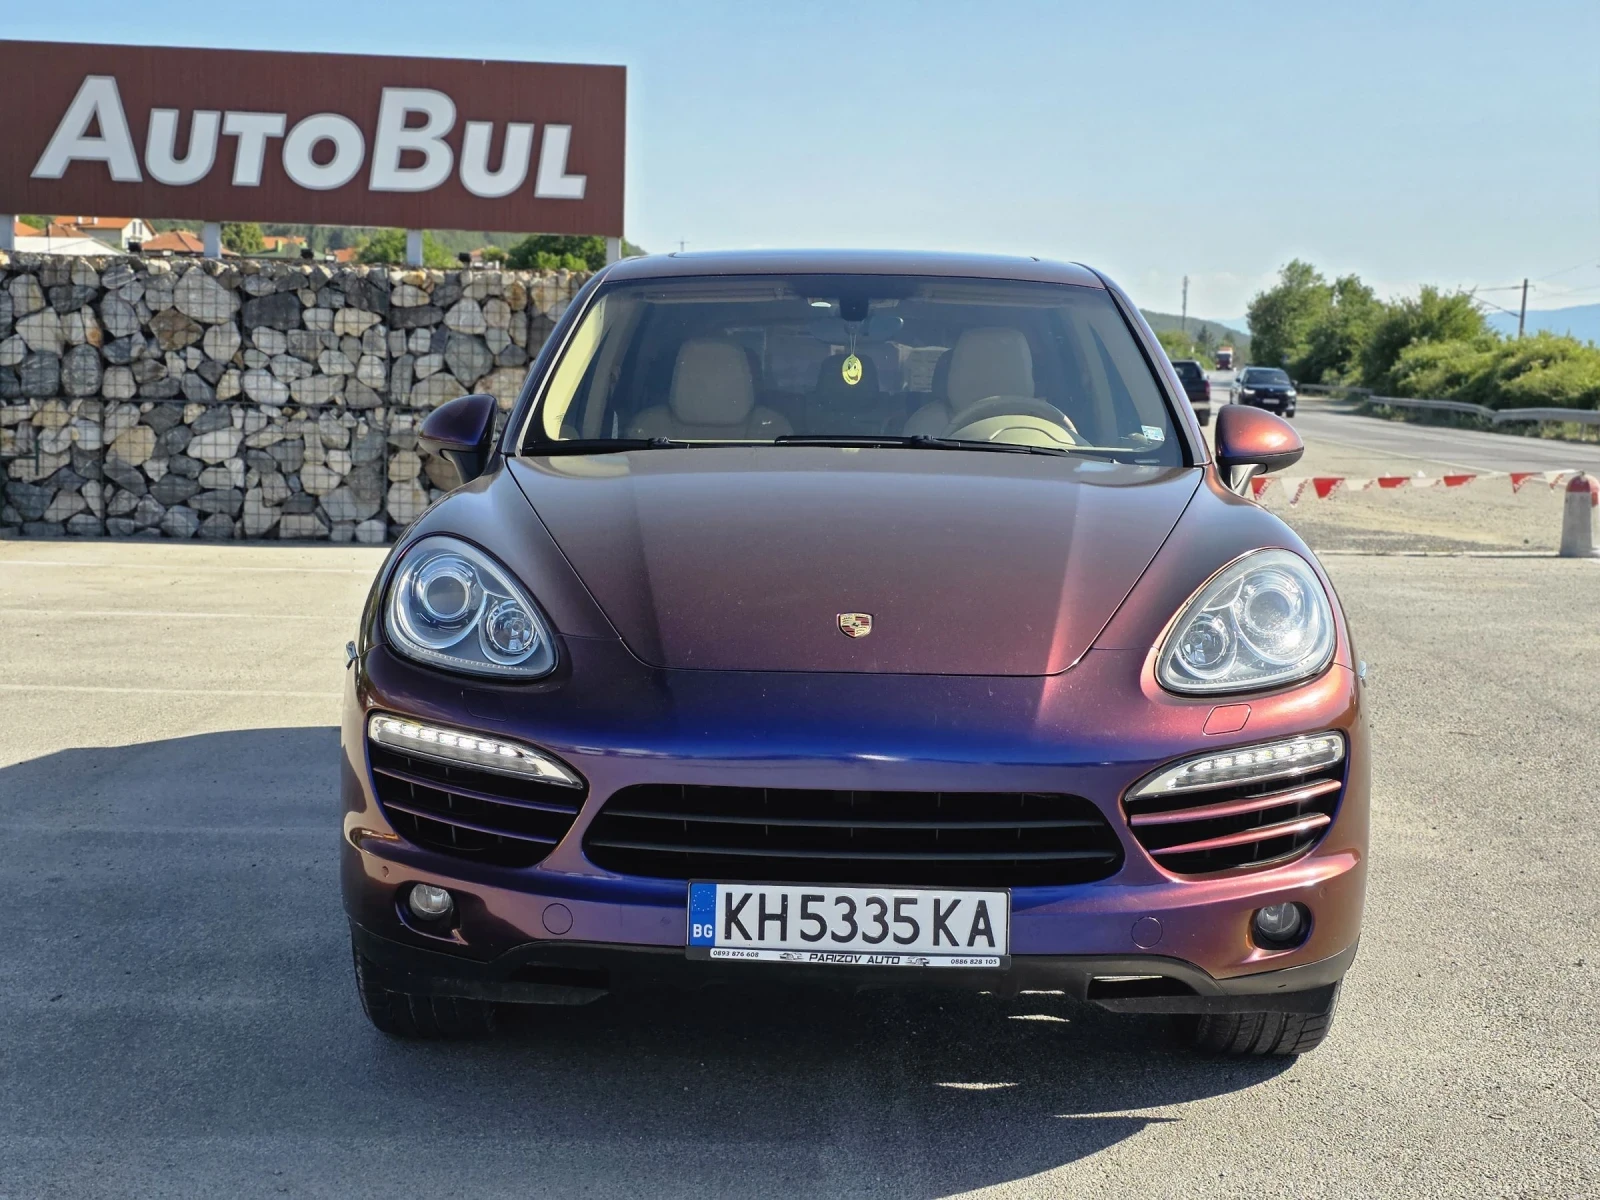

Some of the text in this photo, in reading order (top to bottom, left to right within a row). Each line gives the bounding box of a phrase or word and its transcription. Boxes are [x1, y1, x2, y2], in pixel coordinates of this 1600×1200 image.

[693, 923, 713, 938] BG
[809, 953, 901, 965] PARIZOV AUTO
